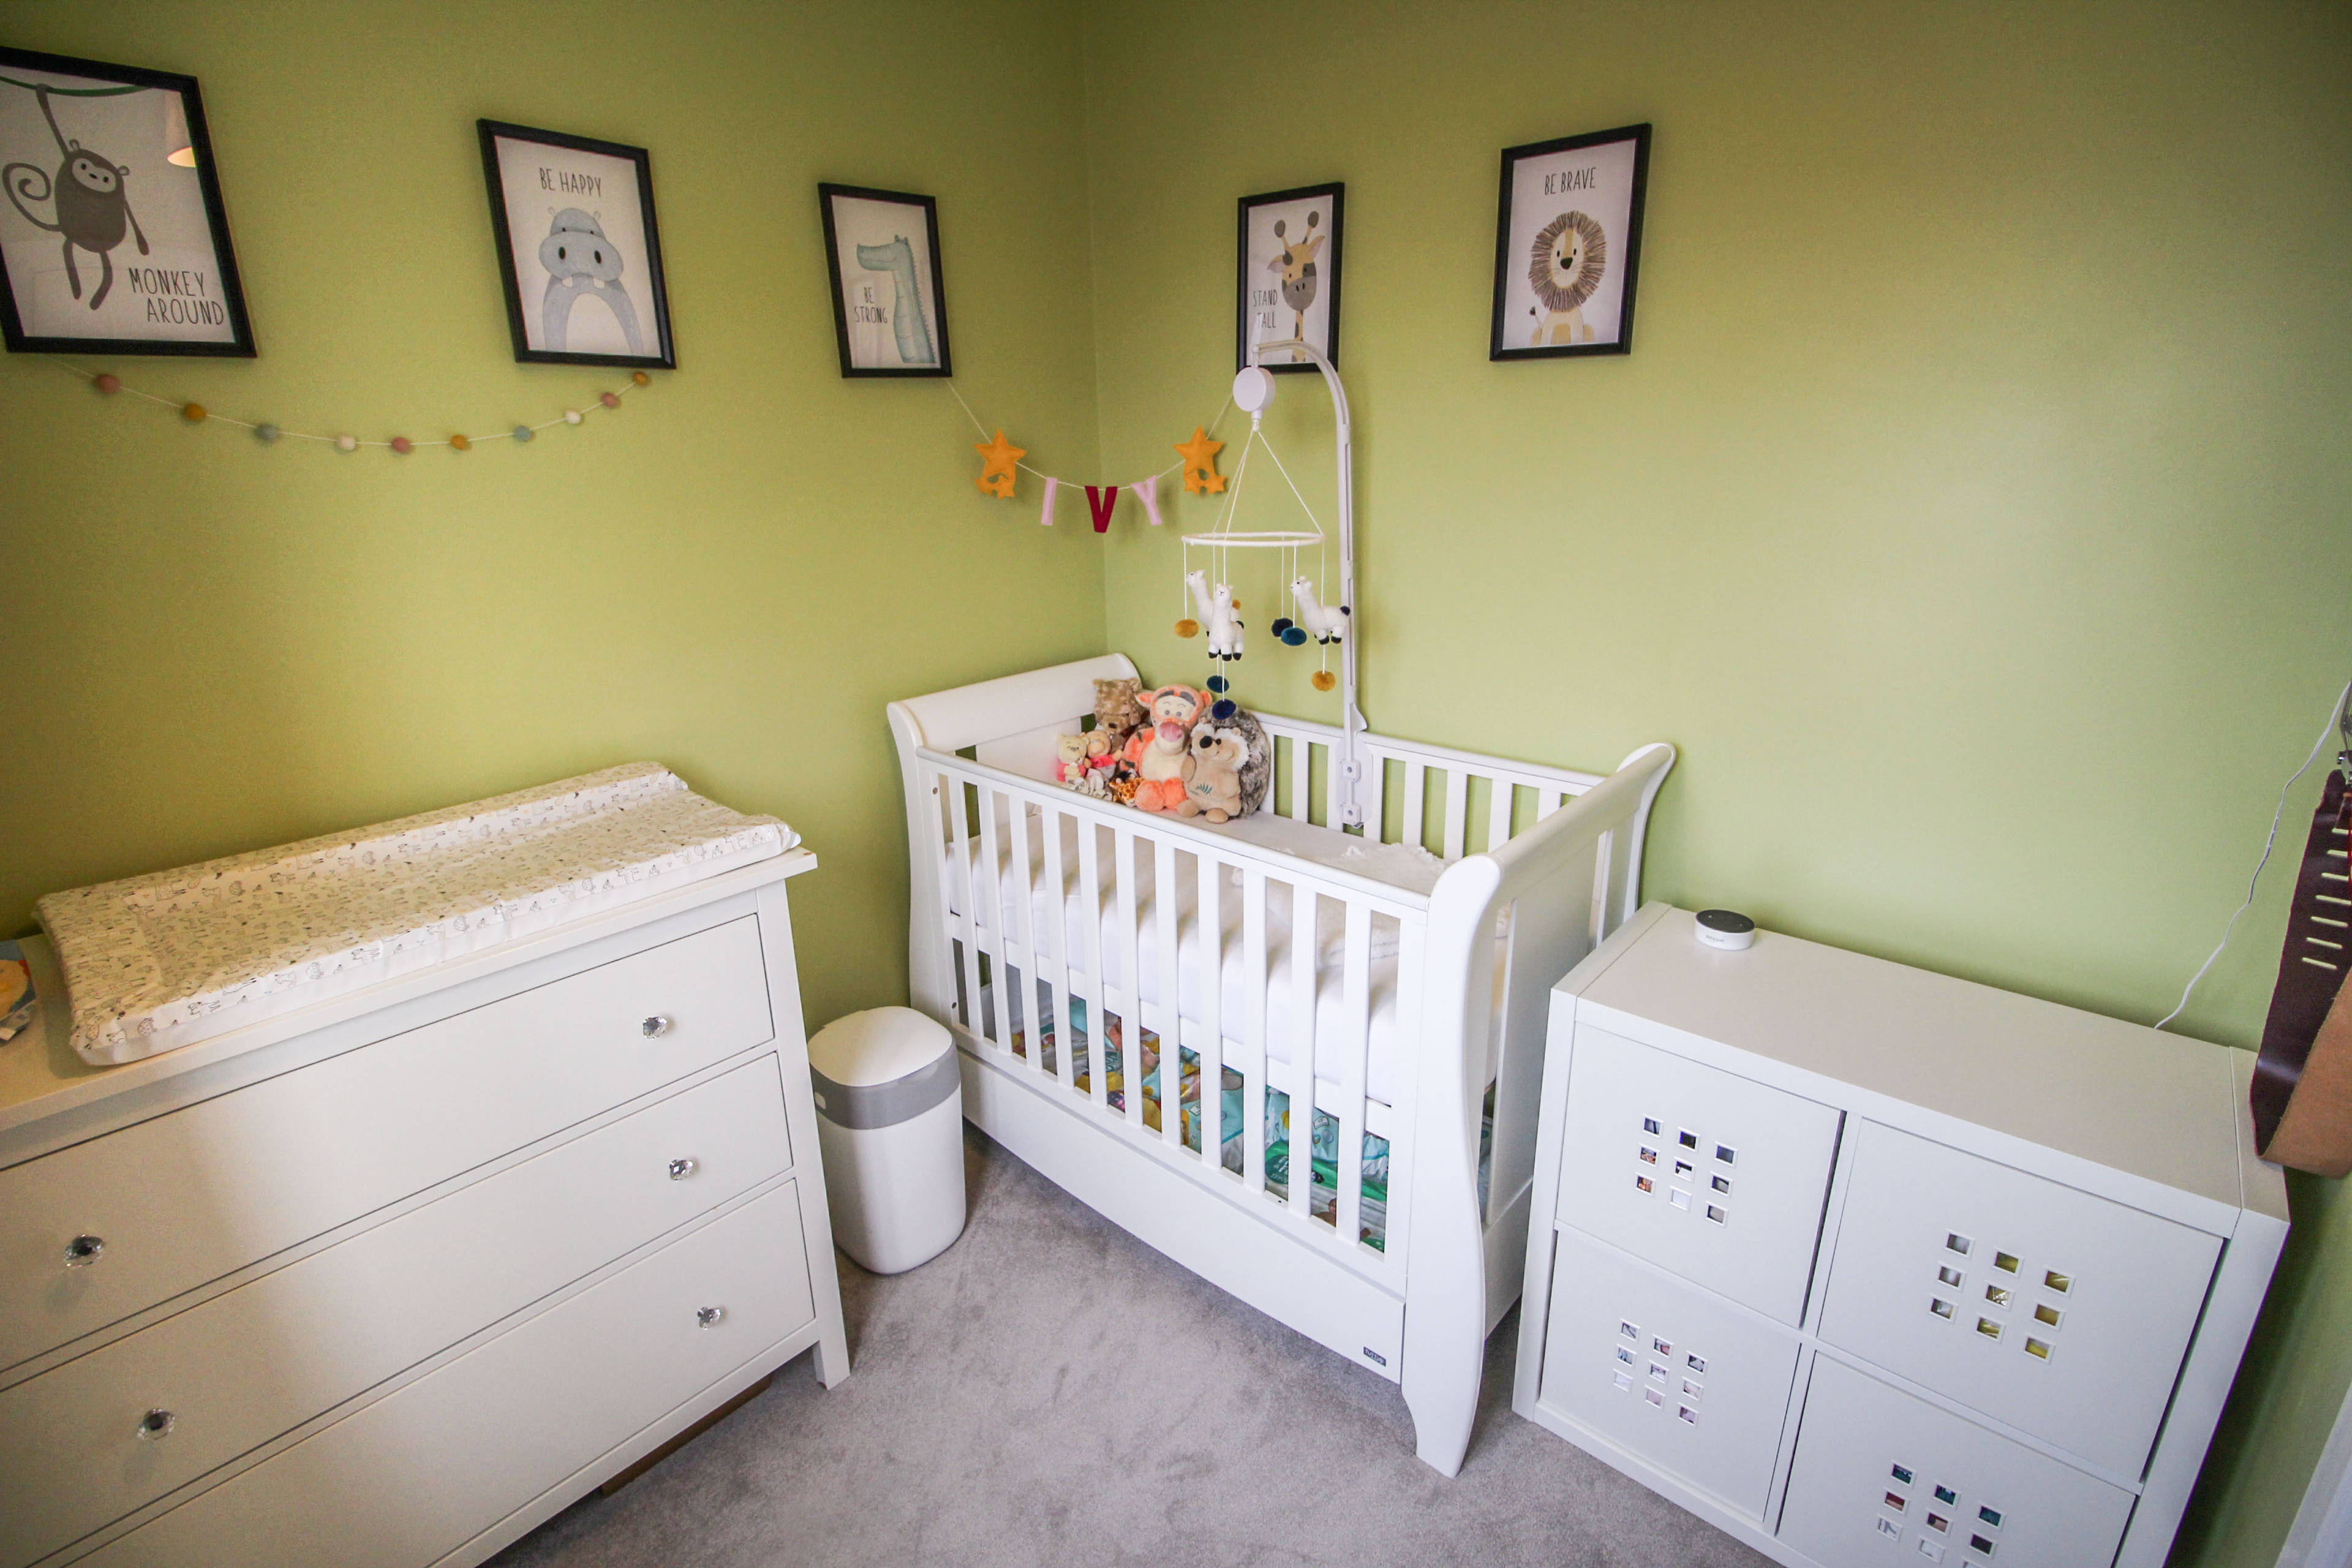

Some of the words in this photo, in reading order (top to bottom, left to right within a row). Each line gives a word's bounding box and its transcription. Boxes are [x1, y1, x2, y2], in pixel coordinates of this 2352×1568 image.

[539, 167, 556, 191] BE
[559, 171, 602, 197] HAPPY
[1544, 173, 1557, 195] BE
[1561, 167, 1597, 193] BRAVE
[129, 267, 205, 297] MONKEY
[864, 287, 874, 304] BE
[1253, 288, 1278, 307] STAND
[147, 298, 225, 326] AROUND
[854, 306, 888, 324] STRONG
